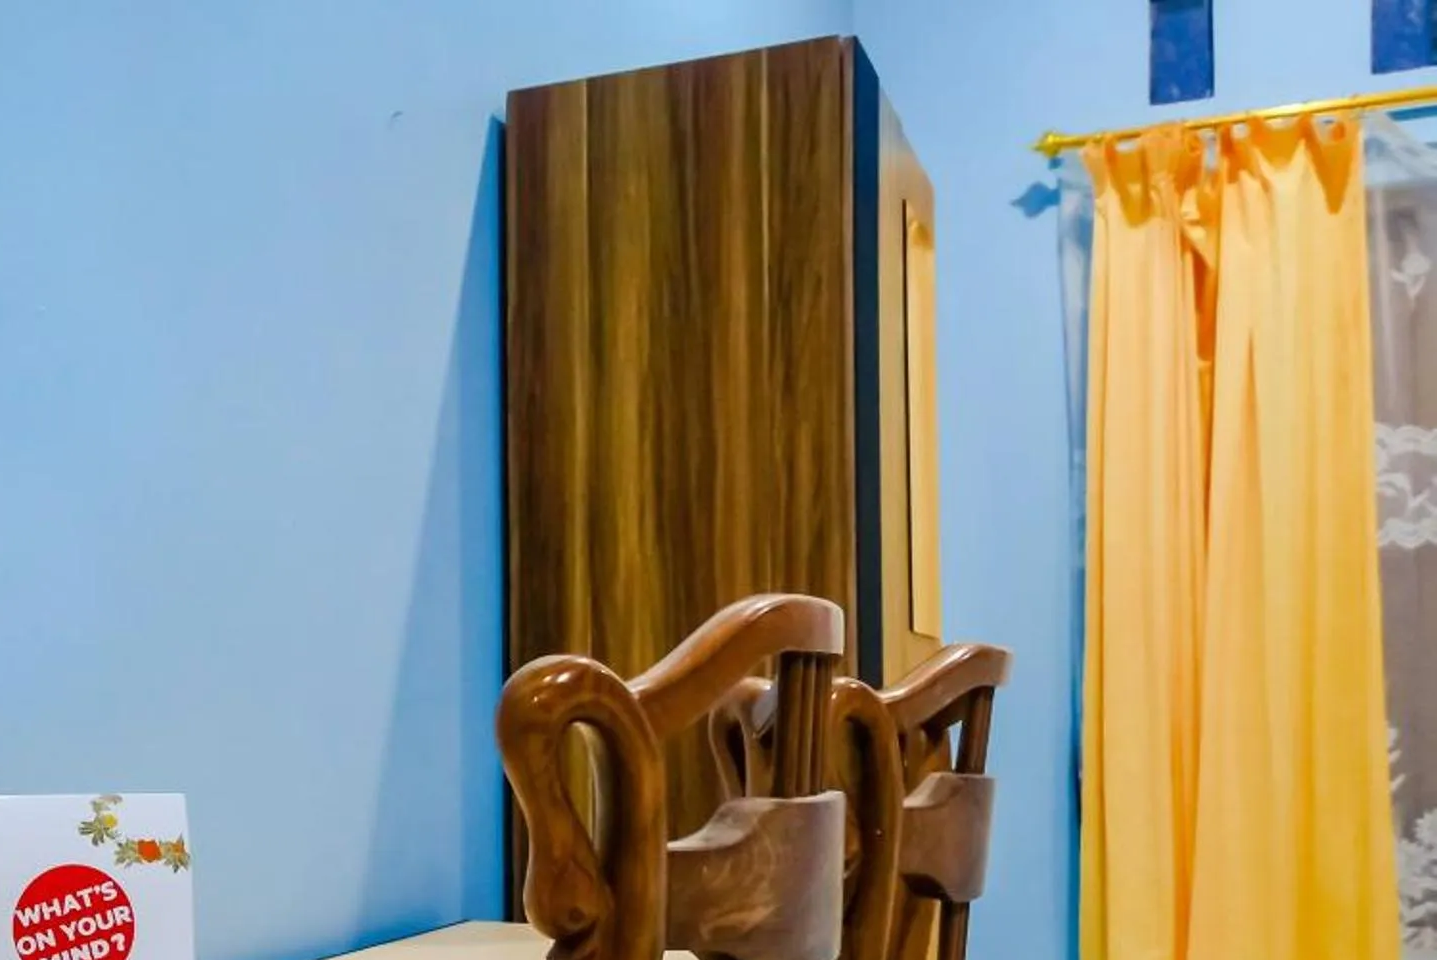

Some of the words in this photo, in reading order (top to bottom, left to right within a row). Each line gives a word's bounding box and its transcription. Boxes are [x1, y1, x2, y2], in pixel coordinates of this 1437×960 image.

[16, 881, 118, 927] WHAT'S
[17, 928, 57, 955] ON
[59, 906, 133, 941] YOUR
